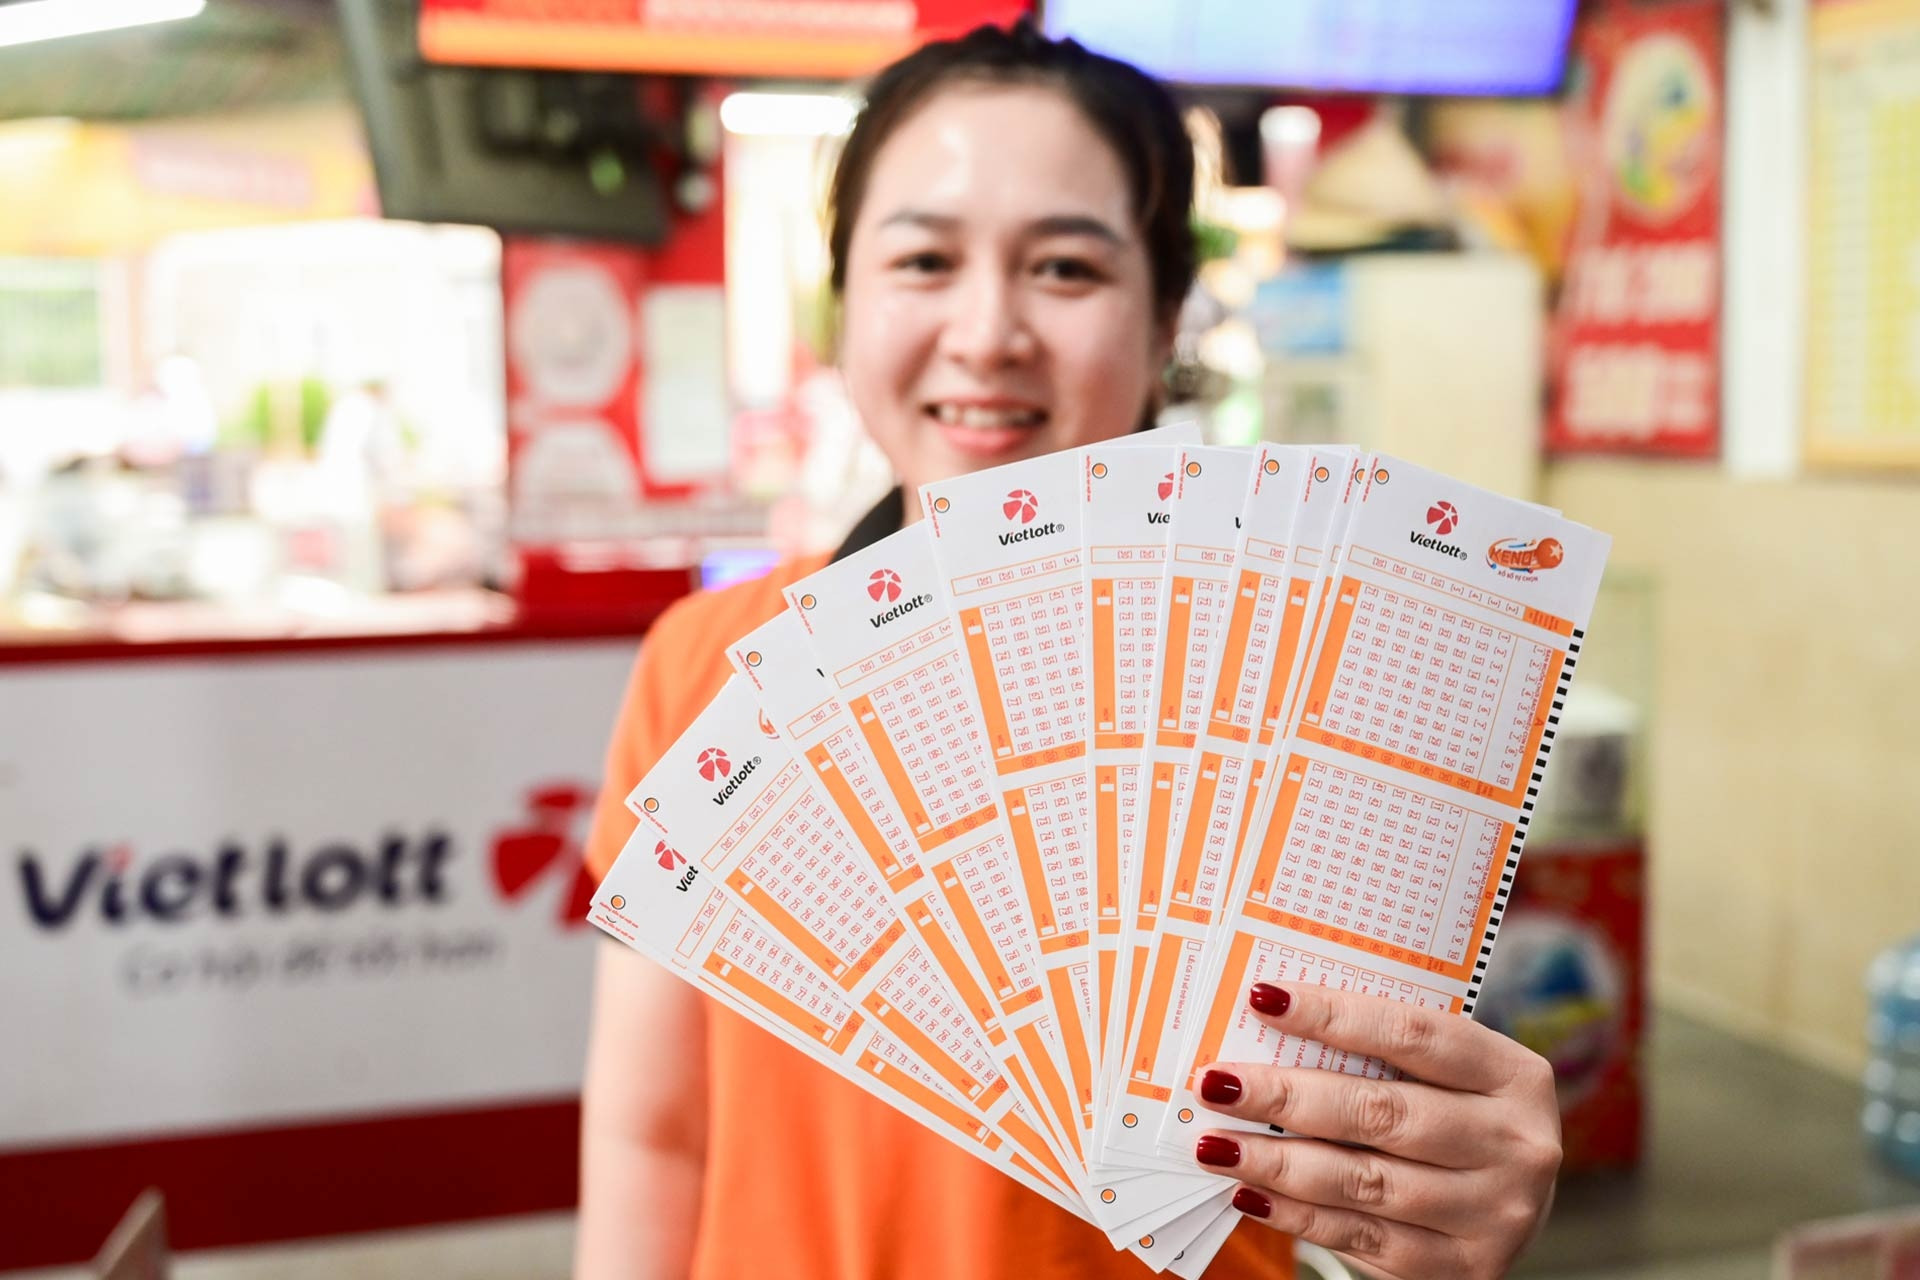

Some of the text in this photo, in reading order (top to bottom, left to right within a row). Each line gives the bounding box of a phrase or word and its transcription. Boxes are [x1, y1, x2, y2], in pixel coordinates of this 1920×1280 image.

[1489, 548, 1533, 567] KENO
[1534, 717, 1545, 729] A
[18, 827, 453, 930] Vietlott
[1485, 891, 1495, 901] B
